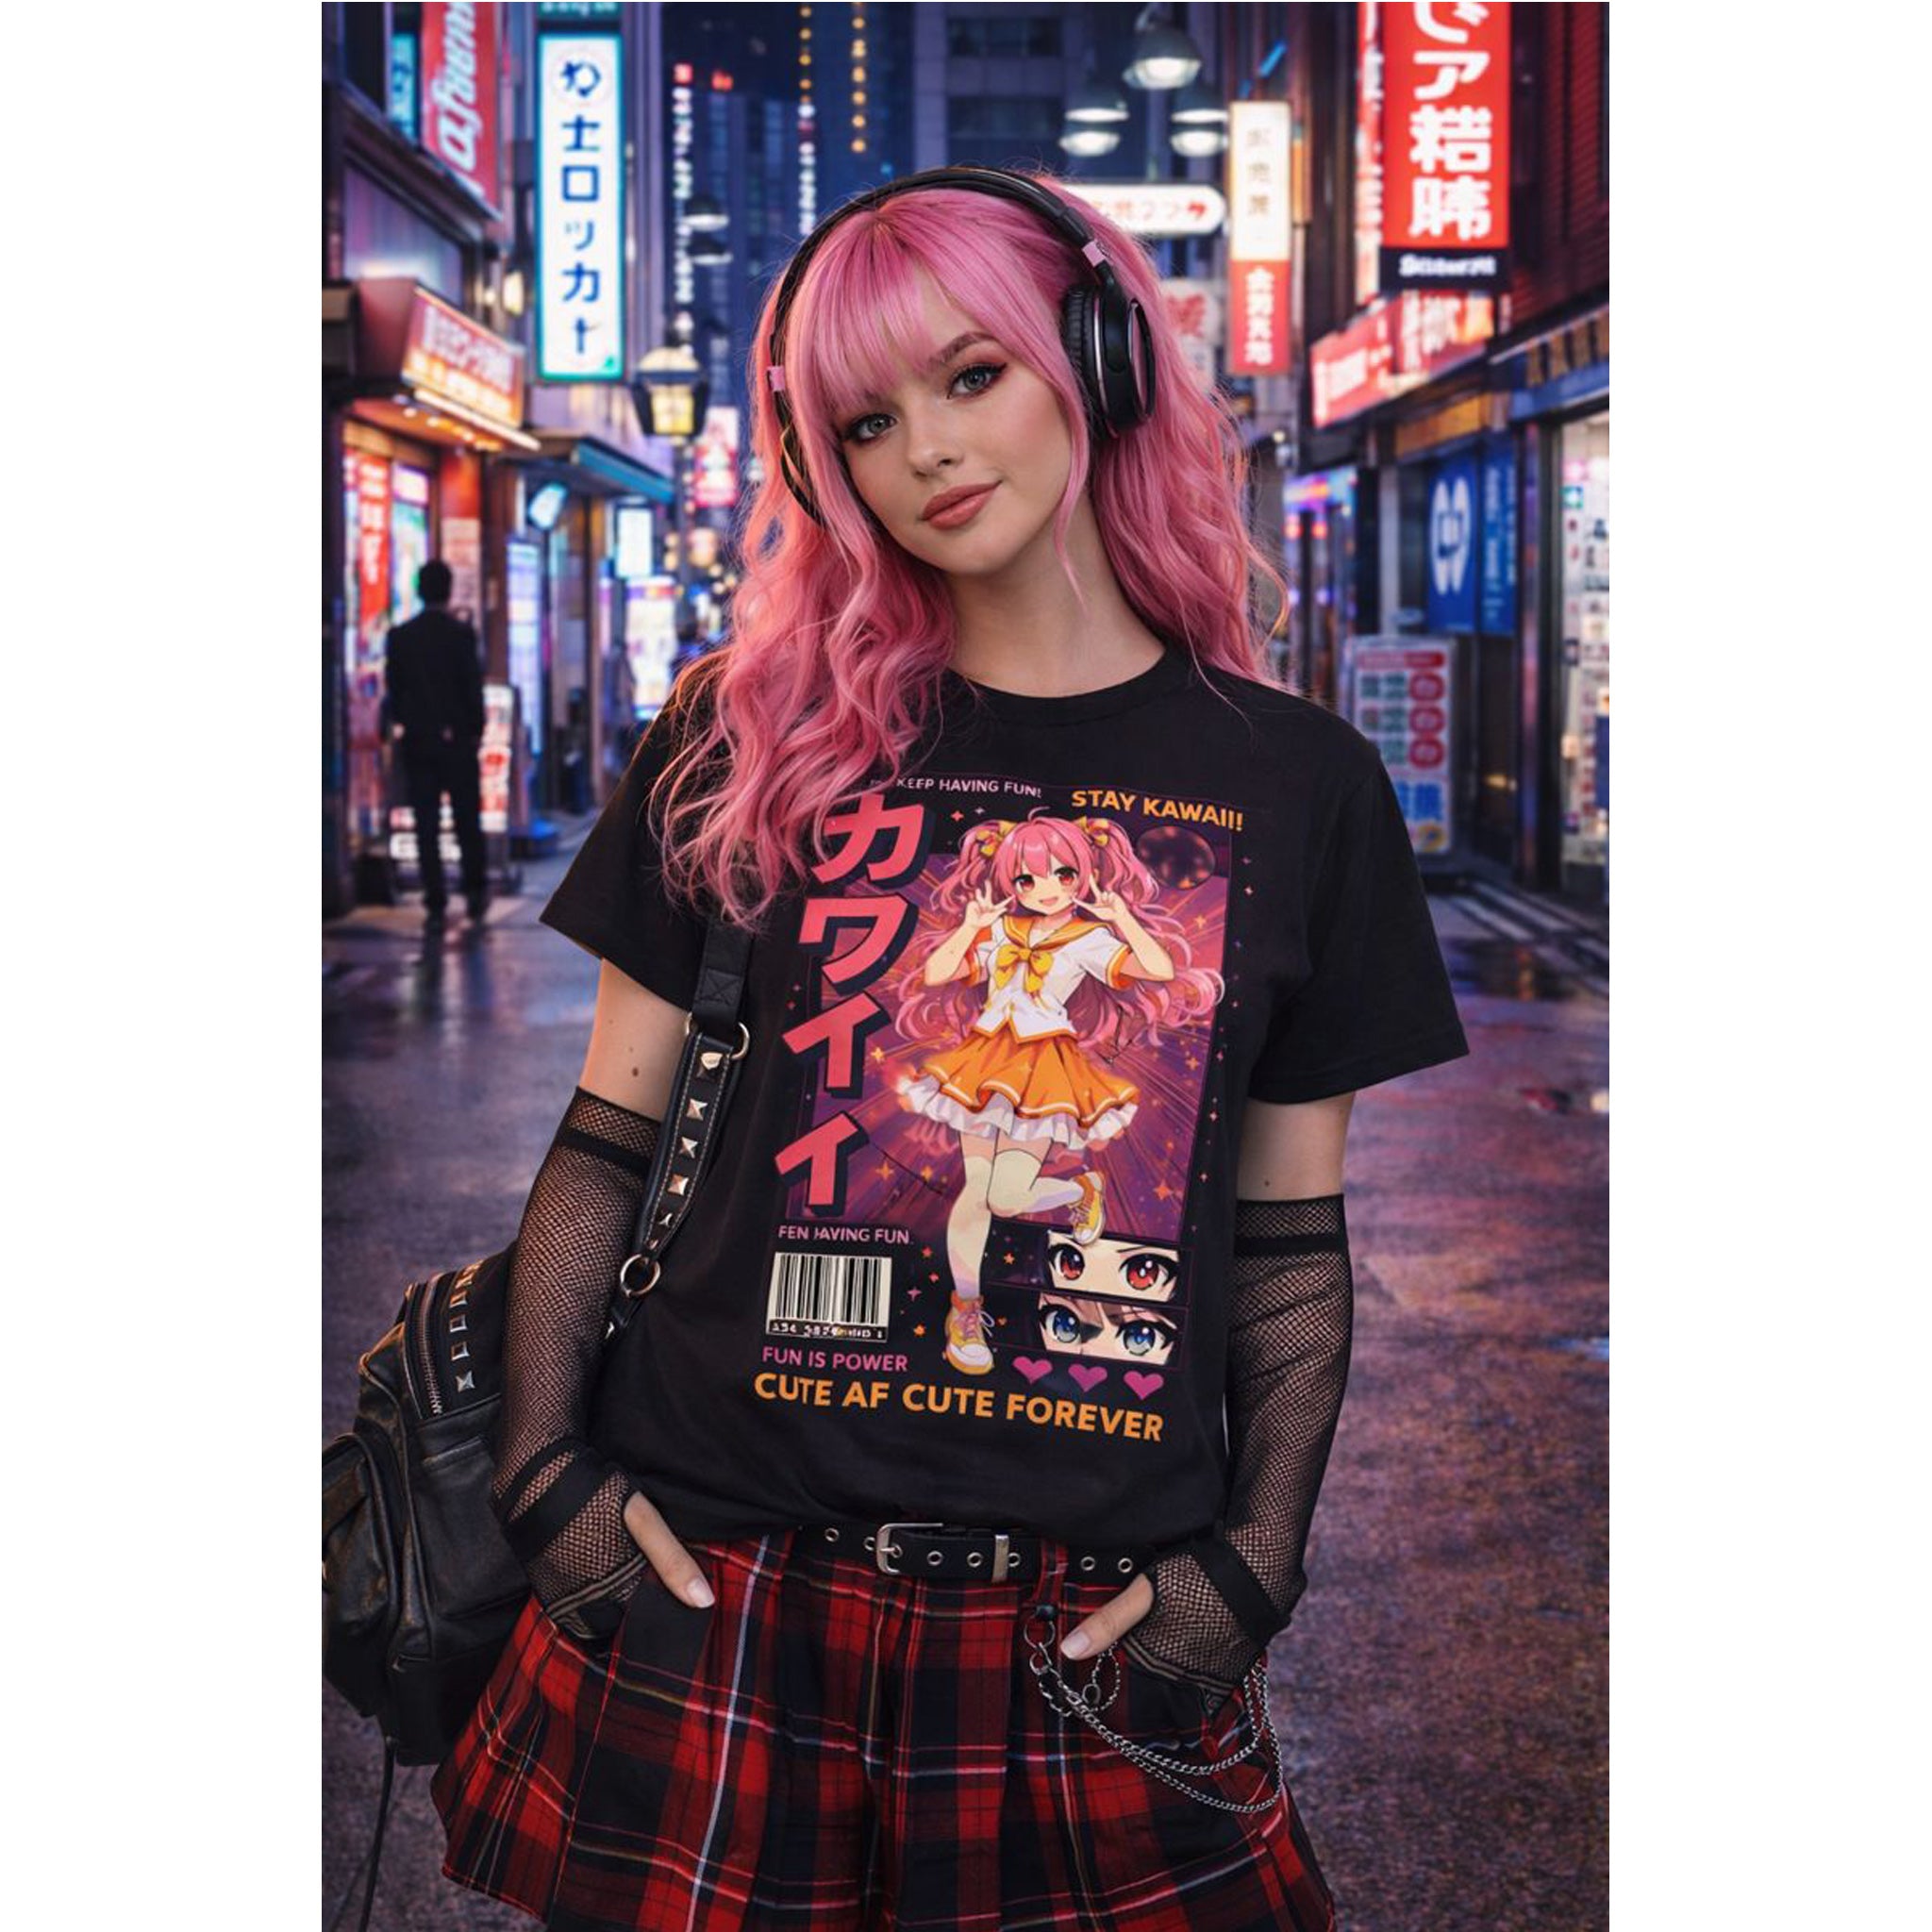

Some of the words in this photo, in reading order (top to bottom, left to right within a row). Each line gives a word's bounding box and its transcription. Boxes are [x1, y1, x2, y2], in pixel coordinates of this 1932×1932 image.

[939, 779, 999, 793] HAVING
[1004, 781, 1041, 799] FUN!
[1072, 790, 1138, 818] STAY
[774, 794, 924, 1206] カワイイ
[778, 1225, 809, 1240] FEN
[762, 1346, 803, 1366] FUN
[808, 1351, 826, 1369] IS
[832, 1353, 908, 1372] POWER
[754, 1373, 833, 1407] CUTE
[842, 1381, 890, 1408] AF
[902, 1383, 994, 1418] CUTE
[1007, 1393, 1164, 1442] FOREVER
